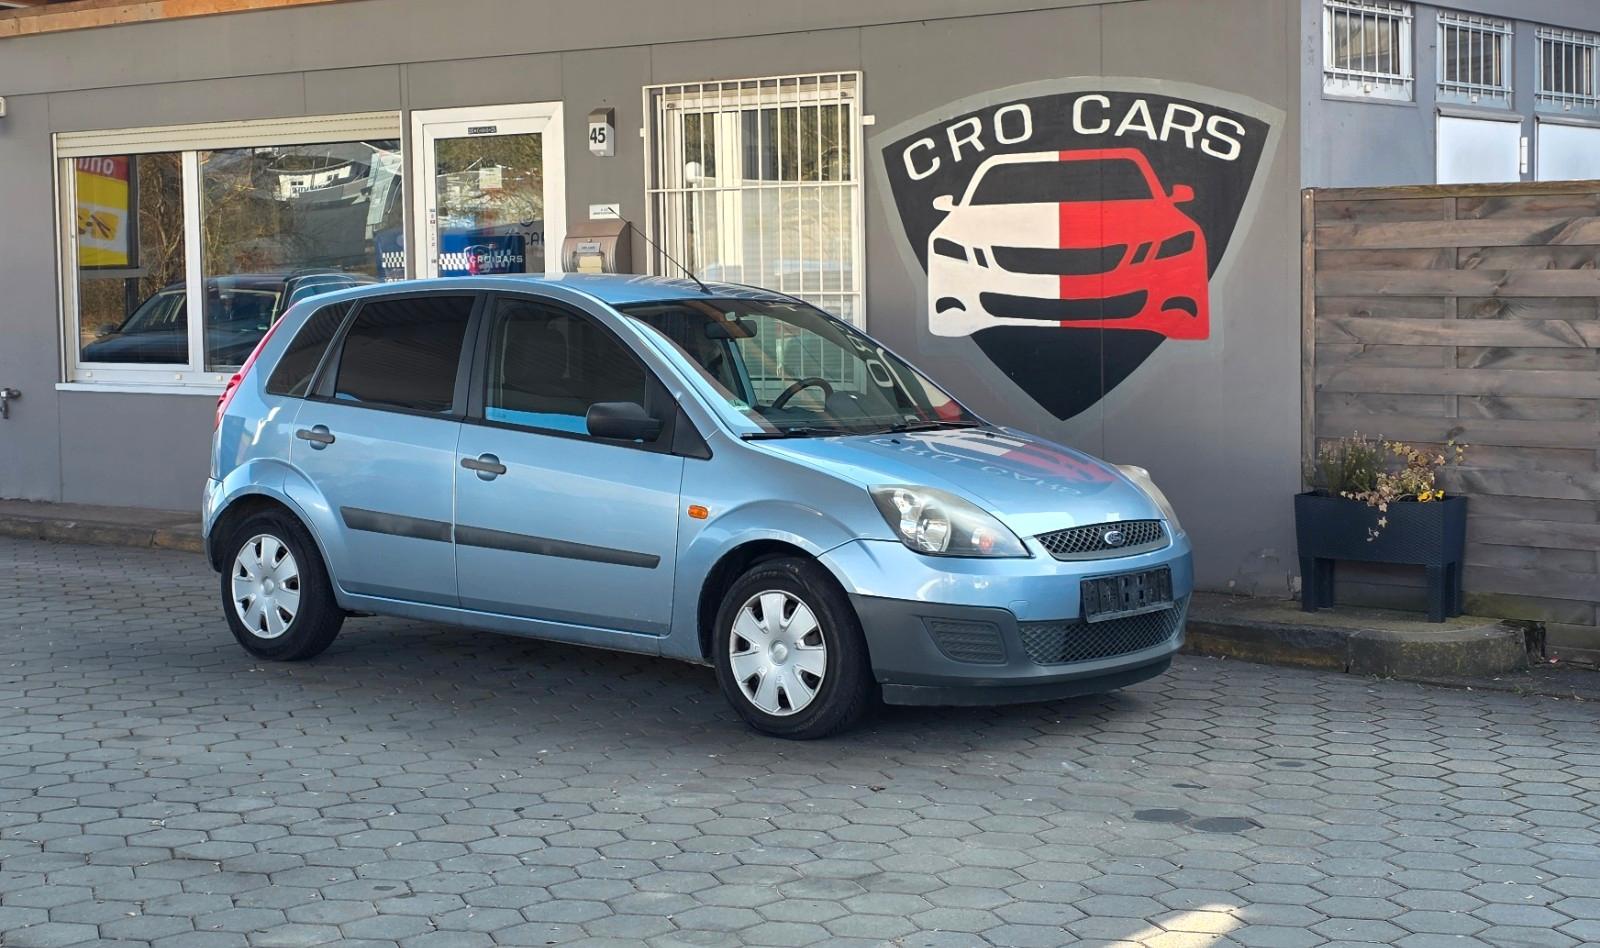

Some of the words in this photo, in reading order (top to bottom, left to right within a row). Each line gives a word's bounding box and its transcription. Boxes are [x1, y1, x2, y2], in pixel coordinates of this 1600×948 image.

[590, 127, 606, 144] 45
[902, 103, 1033, 181] CRO
[1072, 94, 1246, 162] CARS
